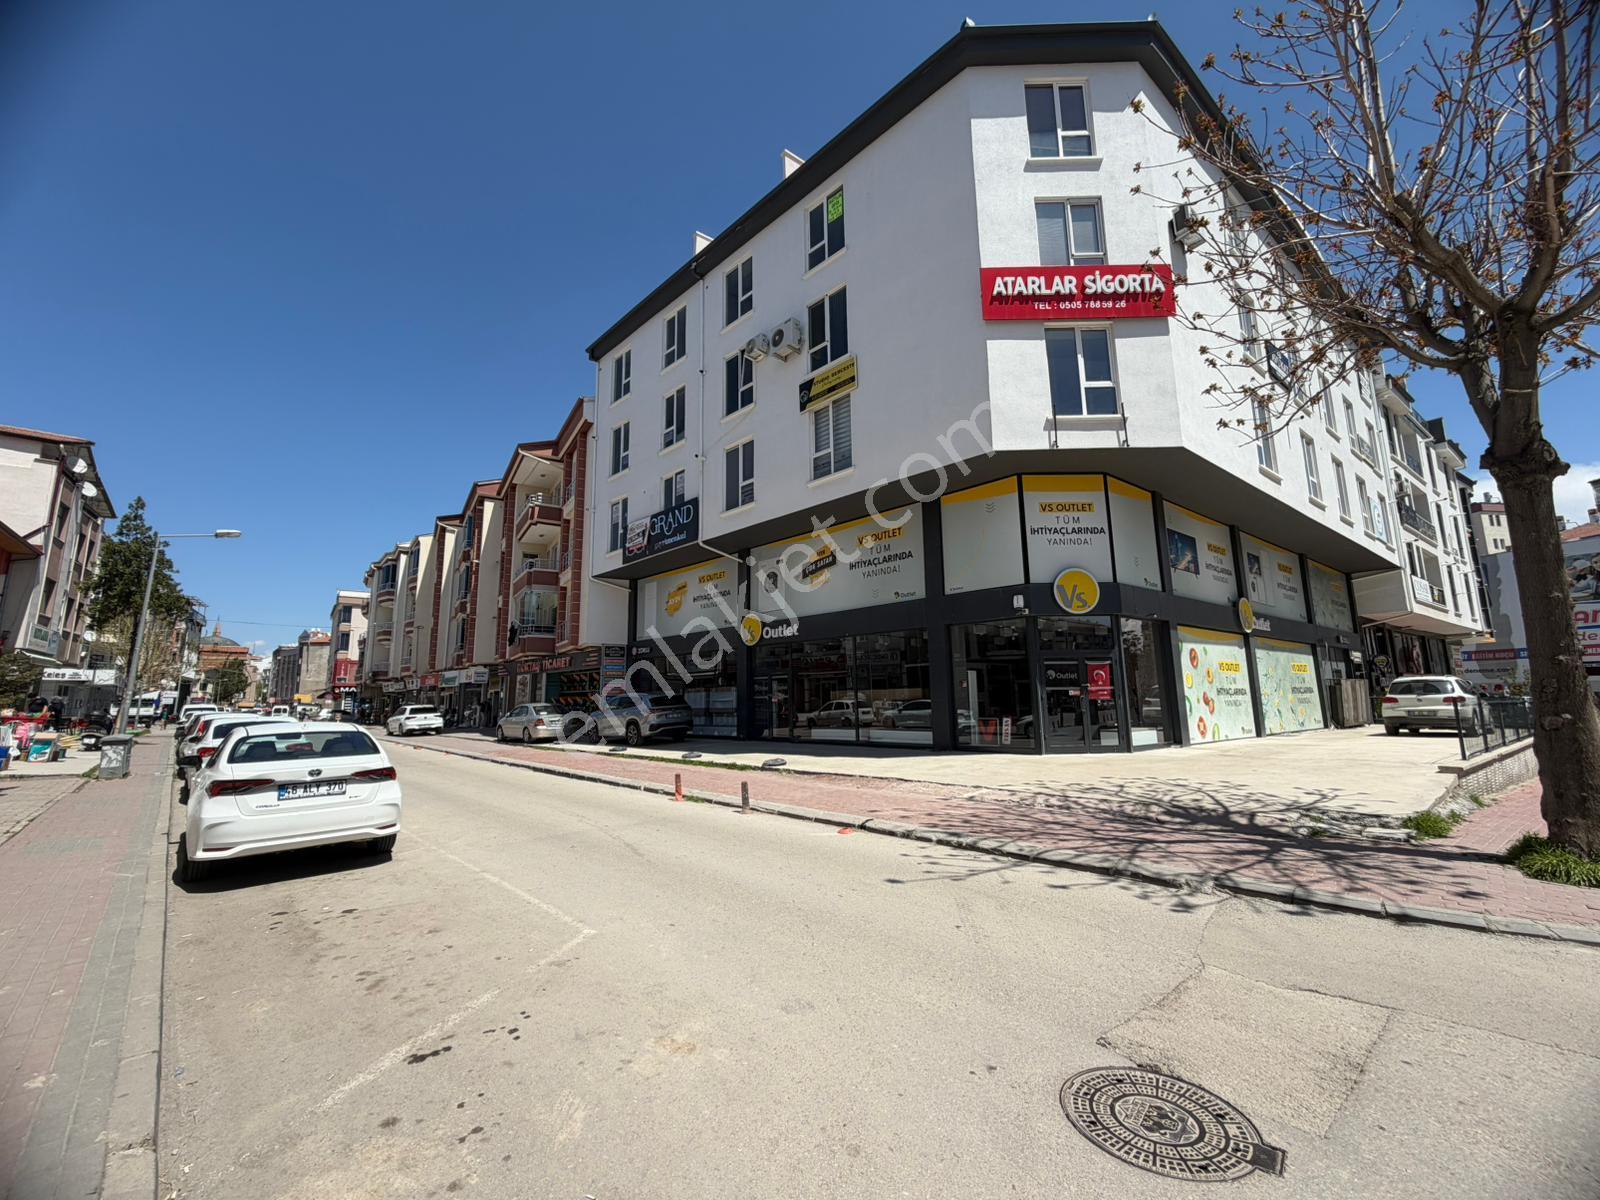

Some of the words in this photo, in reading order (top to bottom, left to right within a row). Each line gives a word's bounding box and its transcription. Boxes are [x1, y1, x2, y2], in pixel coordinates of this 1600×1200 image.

[992, 275, 1078, 297] ATARLAR
[1084, 270, 1166, 295] SİGORTA
[1033, 301, 1052, 310] TEL
[1059, 301, 1082, 309] 0505
[1115, 300, 1127, 308] 26
[1040, 503, 1054, 512] VS
[1056, 503, 1094, 512] OUTLET
[650, 504, 694, 536] GRAND
[1055, 515, 1081, 524] TÜM
[871, 527, 903, 541] OUTLET
[1030, 525, 1106, 536] İHTİYAÇLARINDA
[1046, 537, 1093, 546] YANINDA!
[763, 623, 799, 639] Outlet
[1056, 671, 1078, 680] Outlet
[303, 784, 321, 794] ALY
[326, 781, 344, 792] 370
